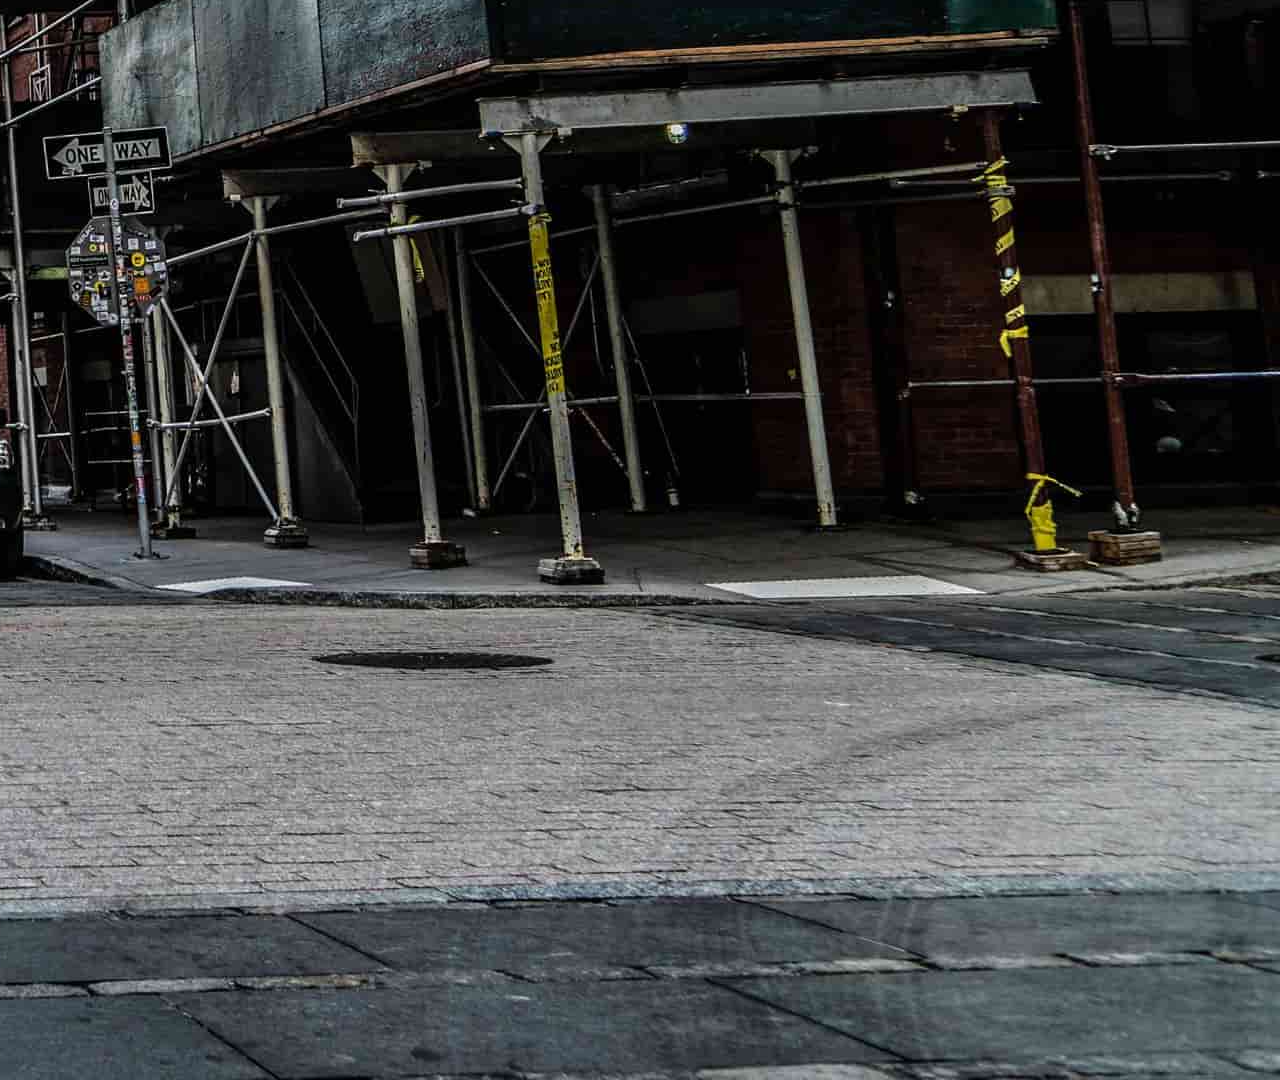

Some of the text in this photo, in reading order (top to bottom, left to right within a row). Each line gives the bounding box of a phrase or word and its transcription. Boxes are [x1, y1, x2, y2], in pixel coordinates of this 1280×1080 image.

[65, 141, 153, 164] ONE WAY
[123, 184, 143, 201] WAY
